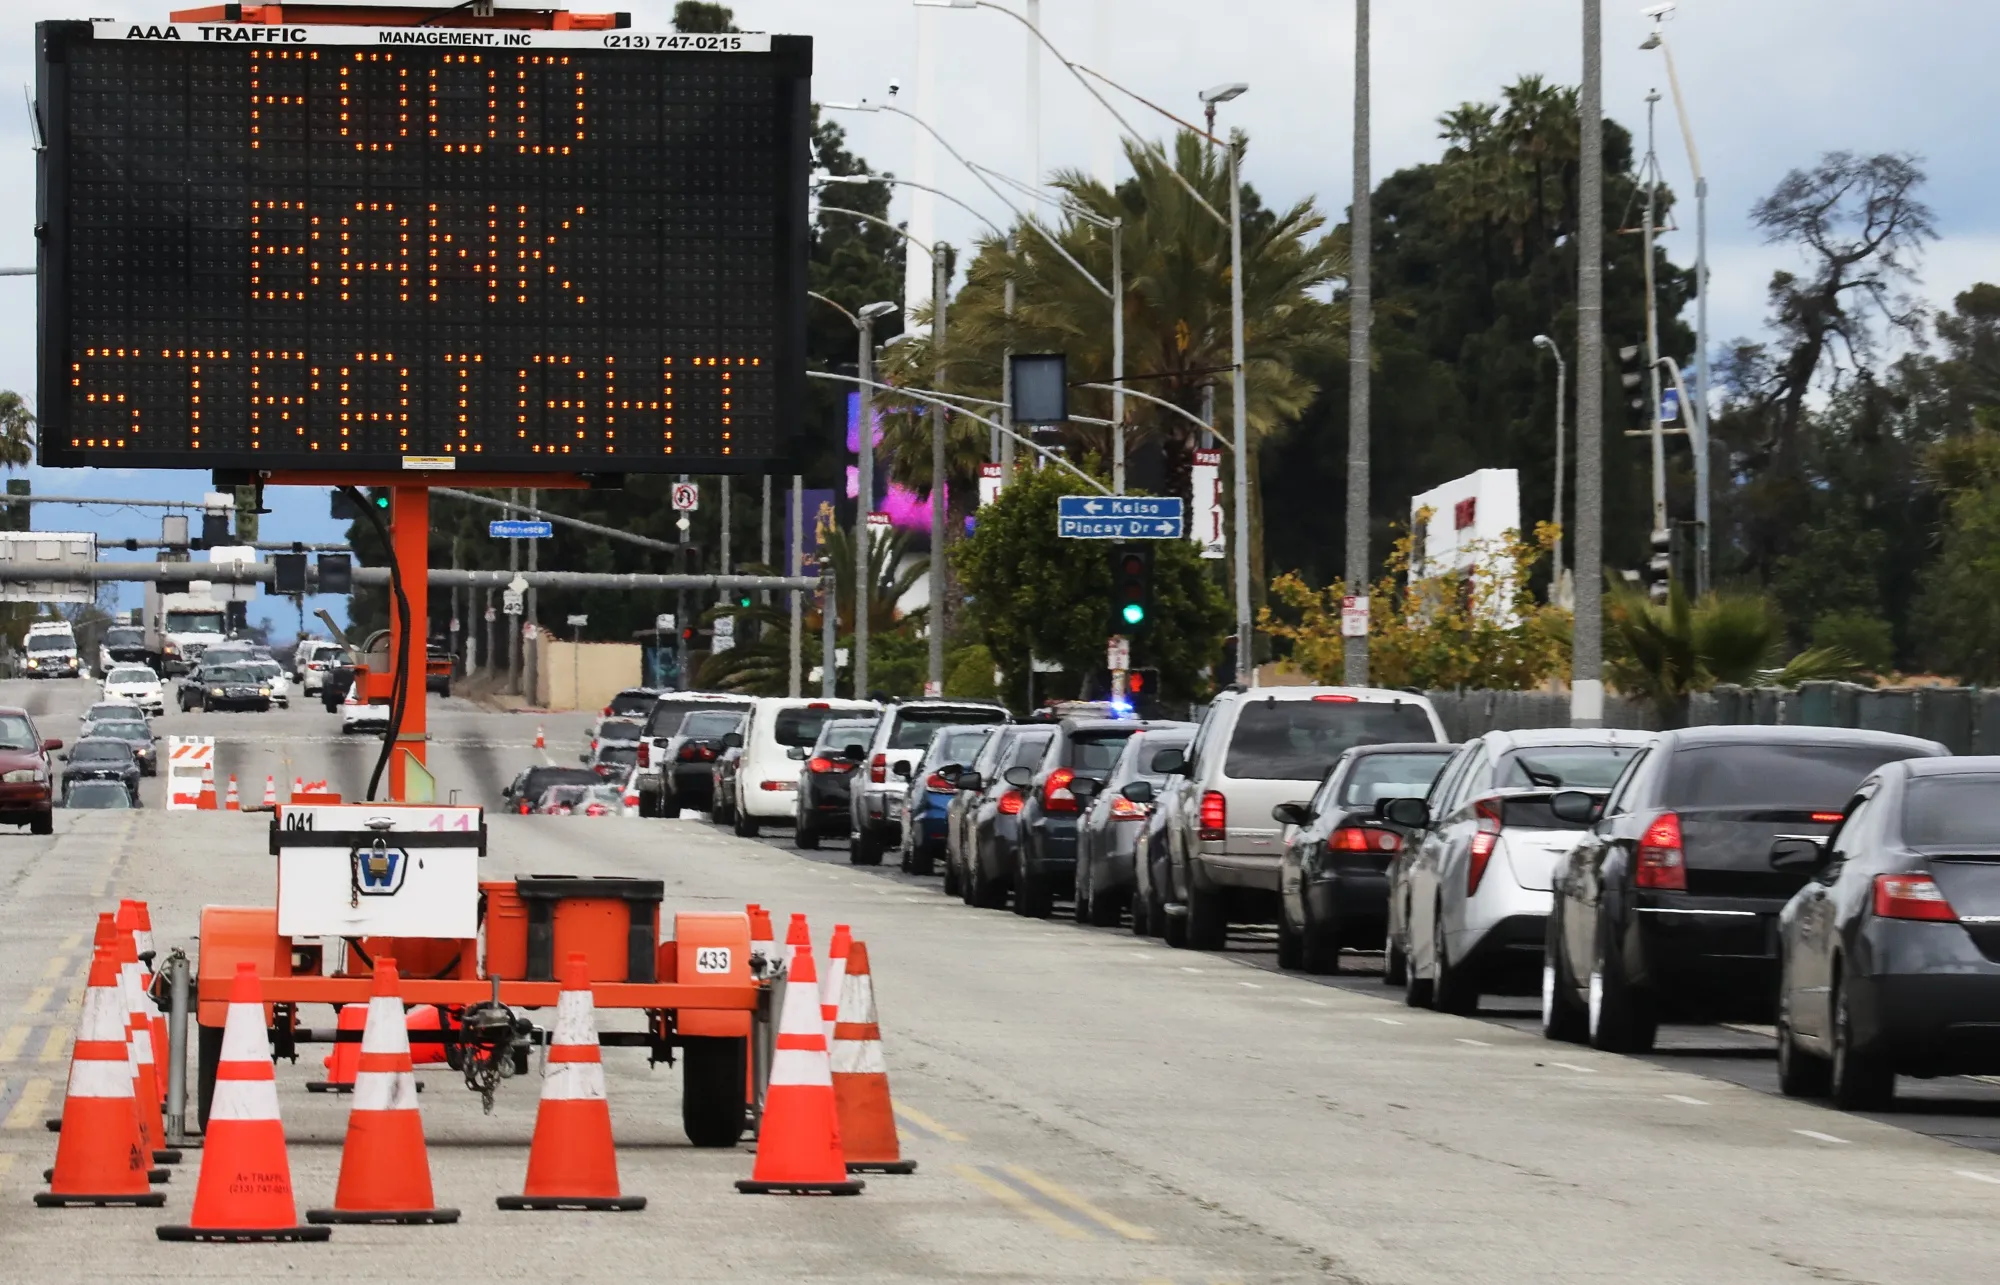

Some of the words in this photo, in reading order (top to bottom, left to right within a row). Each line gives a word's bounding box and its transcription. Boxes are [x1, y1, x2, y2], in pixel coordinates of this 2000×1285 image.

[126, 25, 181, 40] AAA
[198, 26, 308, 43] TRAFFIC
[378, 31, 500, 47] MANAGEMENT,
[503, 34, 532, 46] INC
[603, 35, 651, 50] (213)
[656, 36, 741, 51] 747-0215
[251, 50, 586, 155] FOOD
[251, 201, 586, 304] BANK
[71, 348, 760, 455] STRAIGHT
[1064, 521, 1123, 536] Pincay
[1129, 521, 1150, 534] Dr
[358, 853, 400, 887] W
[698, 951, 728, 969] 433
